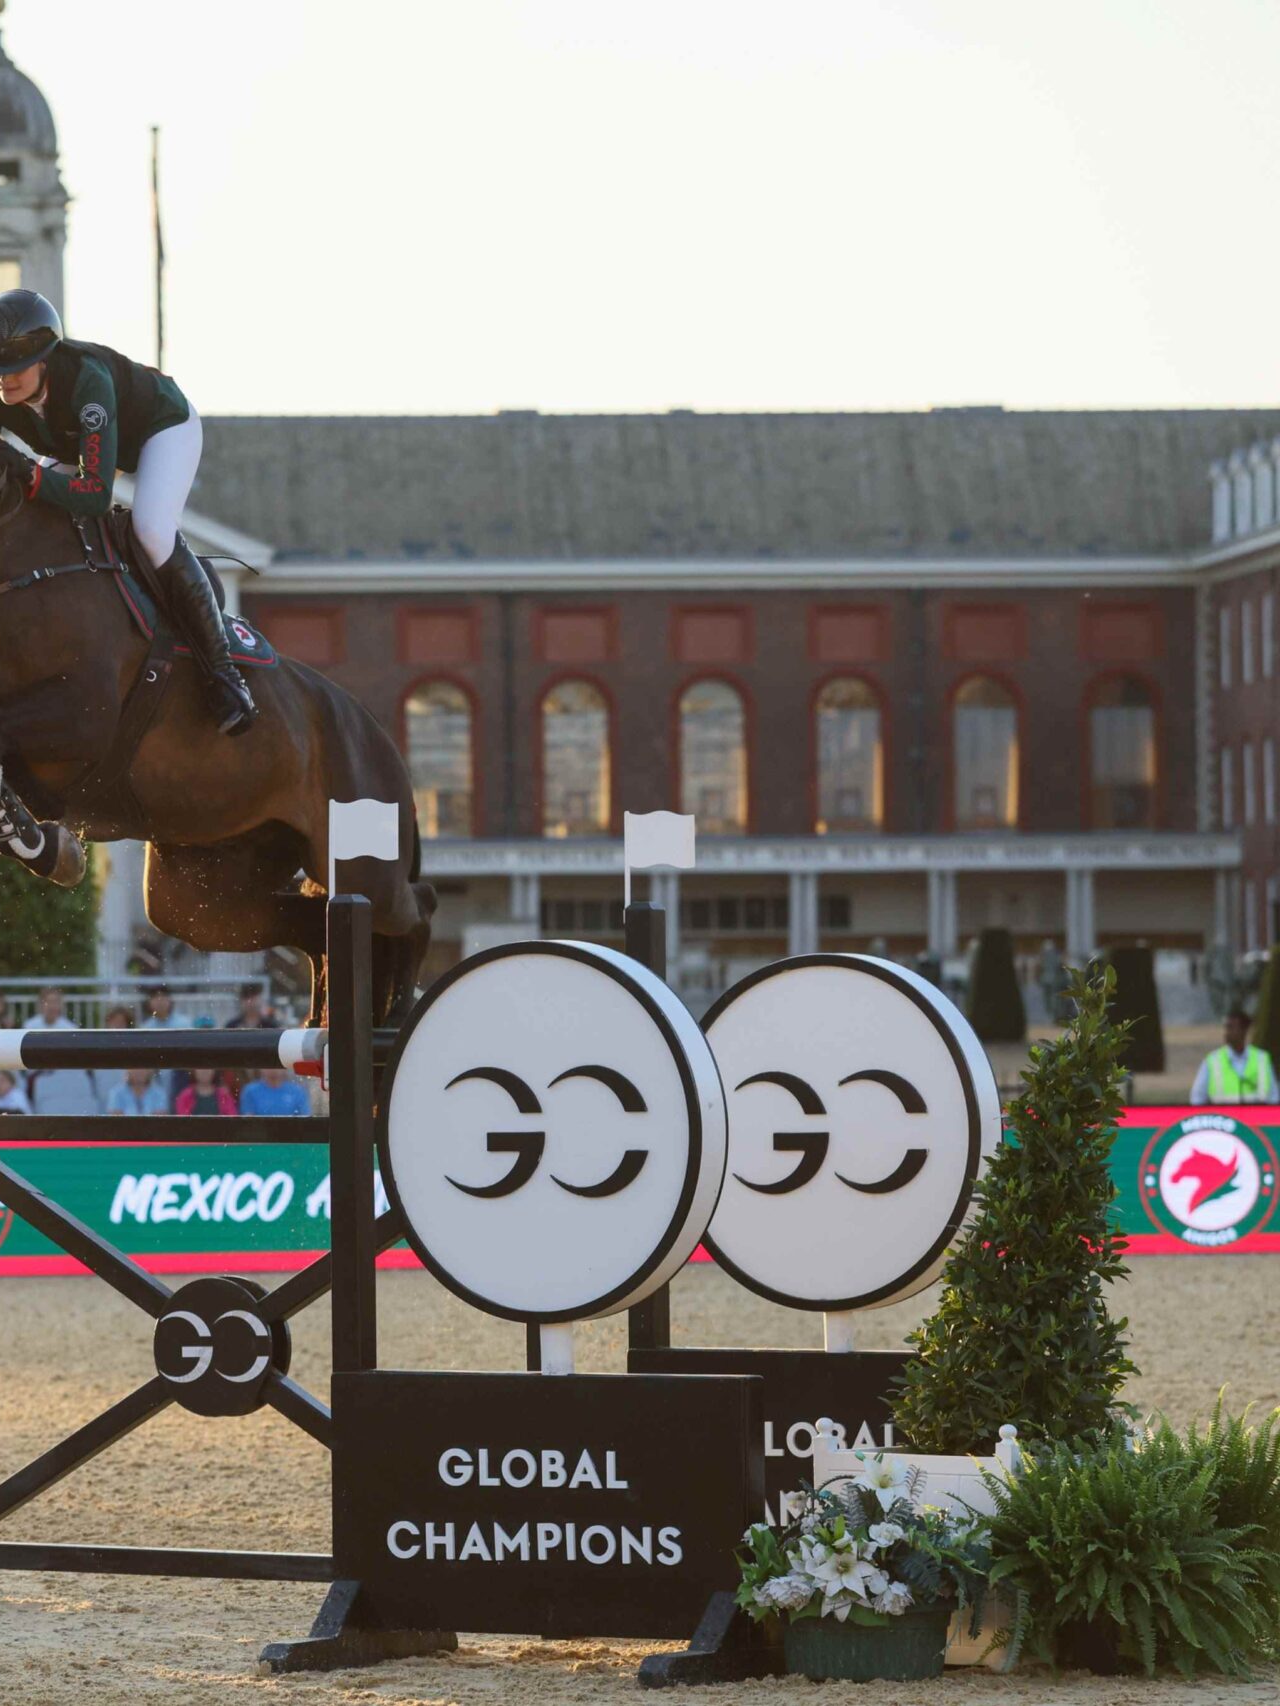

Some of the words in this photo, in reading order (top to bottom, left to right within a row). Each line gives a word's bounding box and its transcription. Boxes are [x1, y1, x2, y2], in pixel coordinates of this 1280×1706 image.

[109, 1171, 295, 1223] MEXICO
[764, 1419, 895, 1458] LOBAL
[438, 1447, 629, 1489] GLOBAL
[386, 1520, 683, 1566] CHAMPIONS
